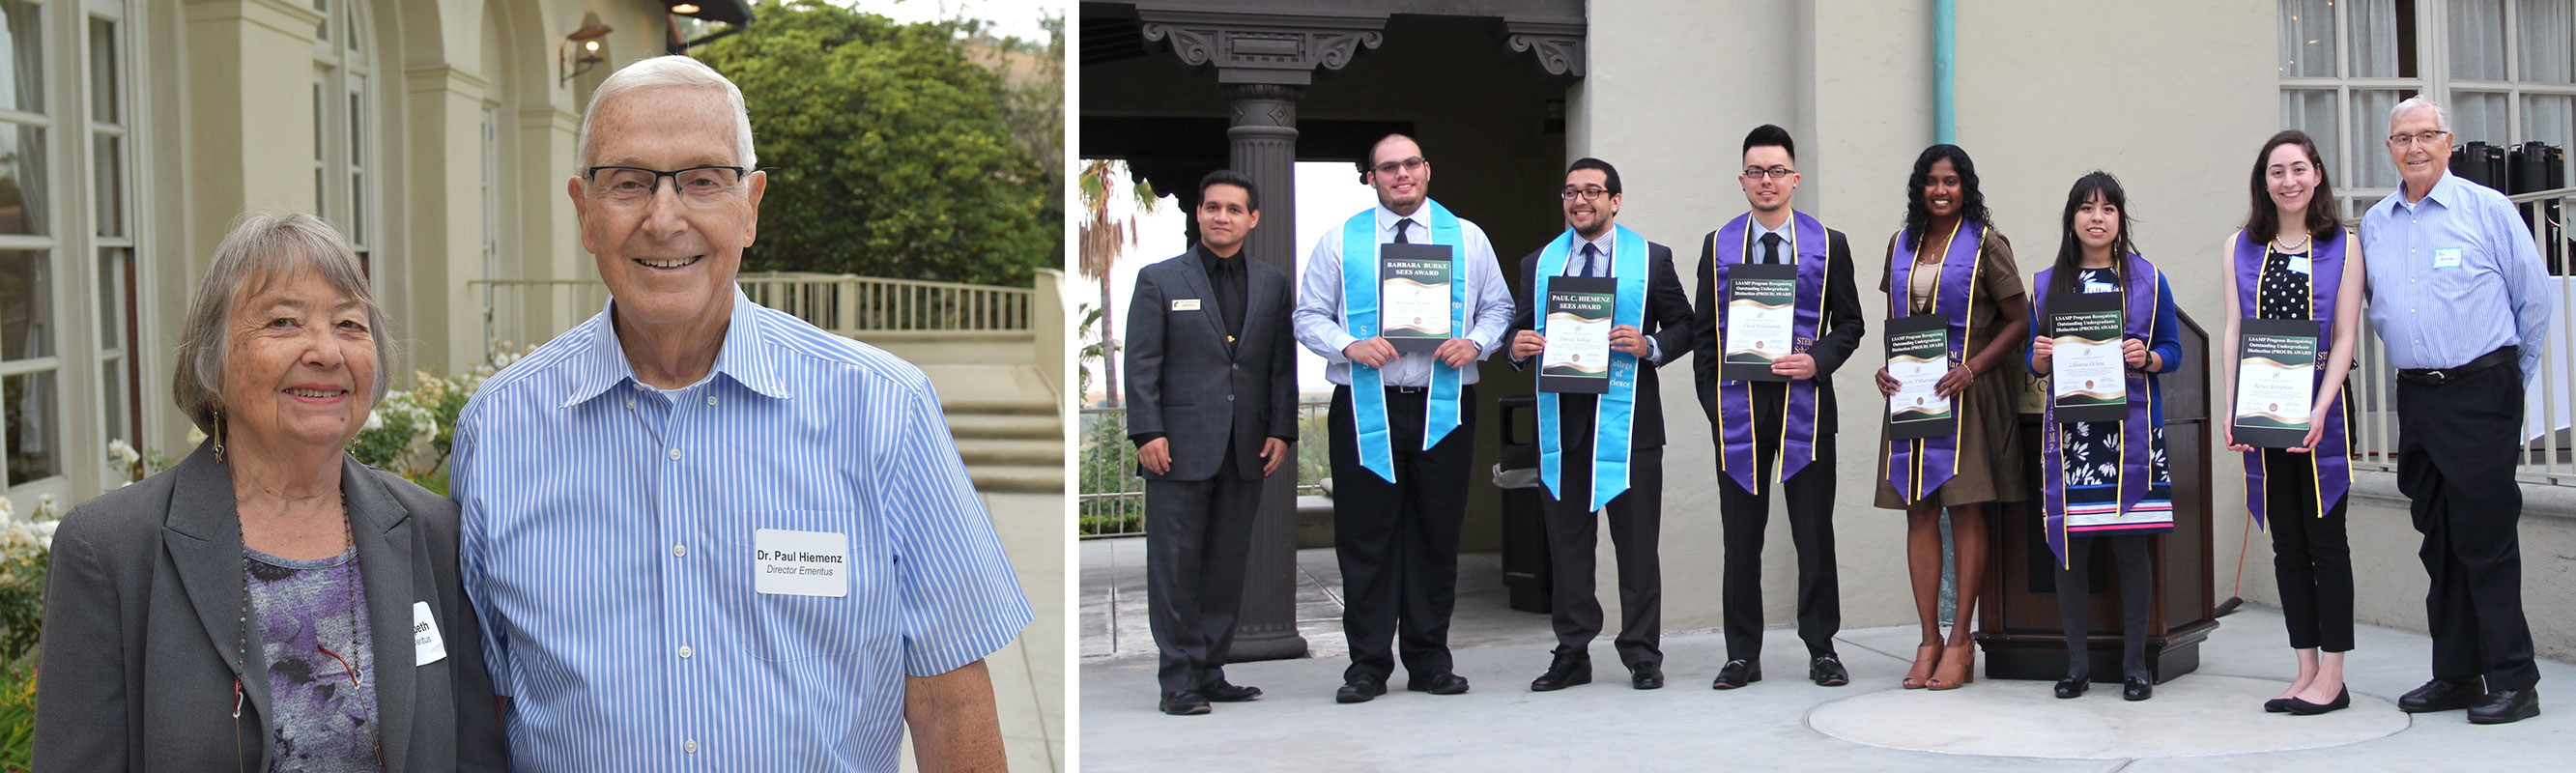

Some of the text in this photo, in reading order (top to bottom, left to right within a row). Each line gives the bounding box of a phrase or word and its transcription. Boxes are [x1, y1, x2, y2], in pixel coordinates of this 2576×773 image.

[1609, 378, 1631, 387] cience
[757, 549, 843, 563] Dr. Paul Hiemenz
[766, 564, 834, 577] Director Emeritus
